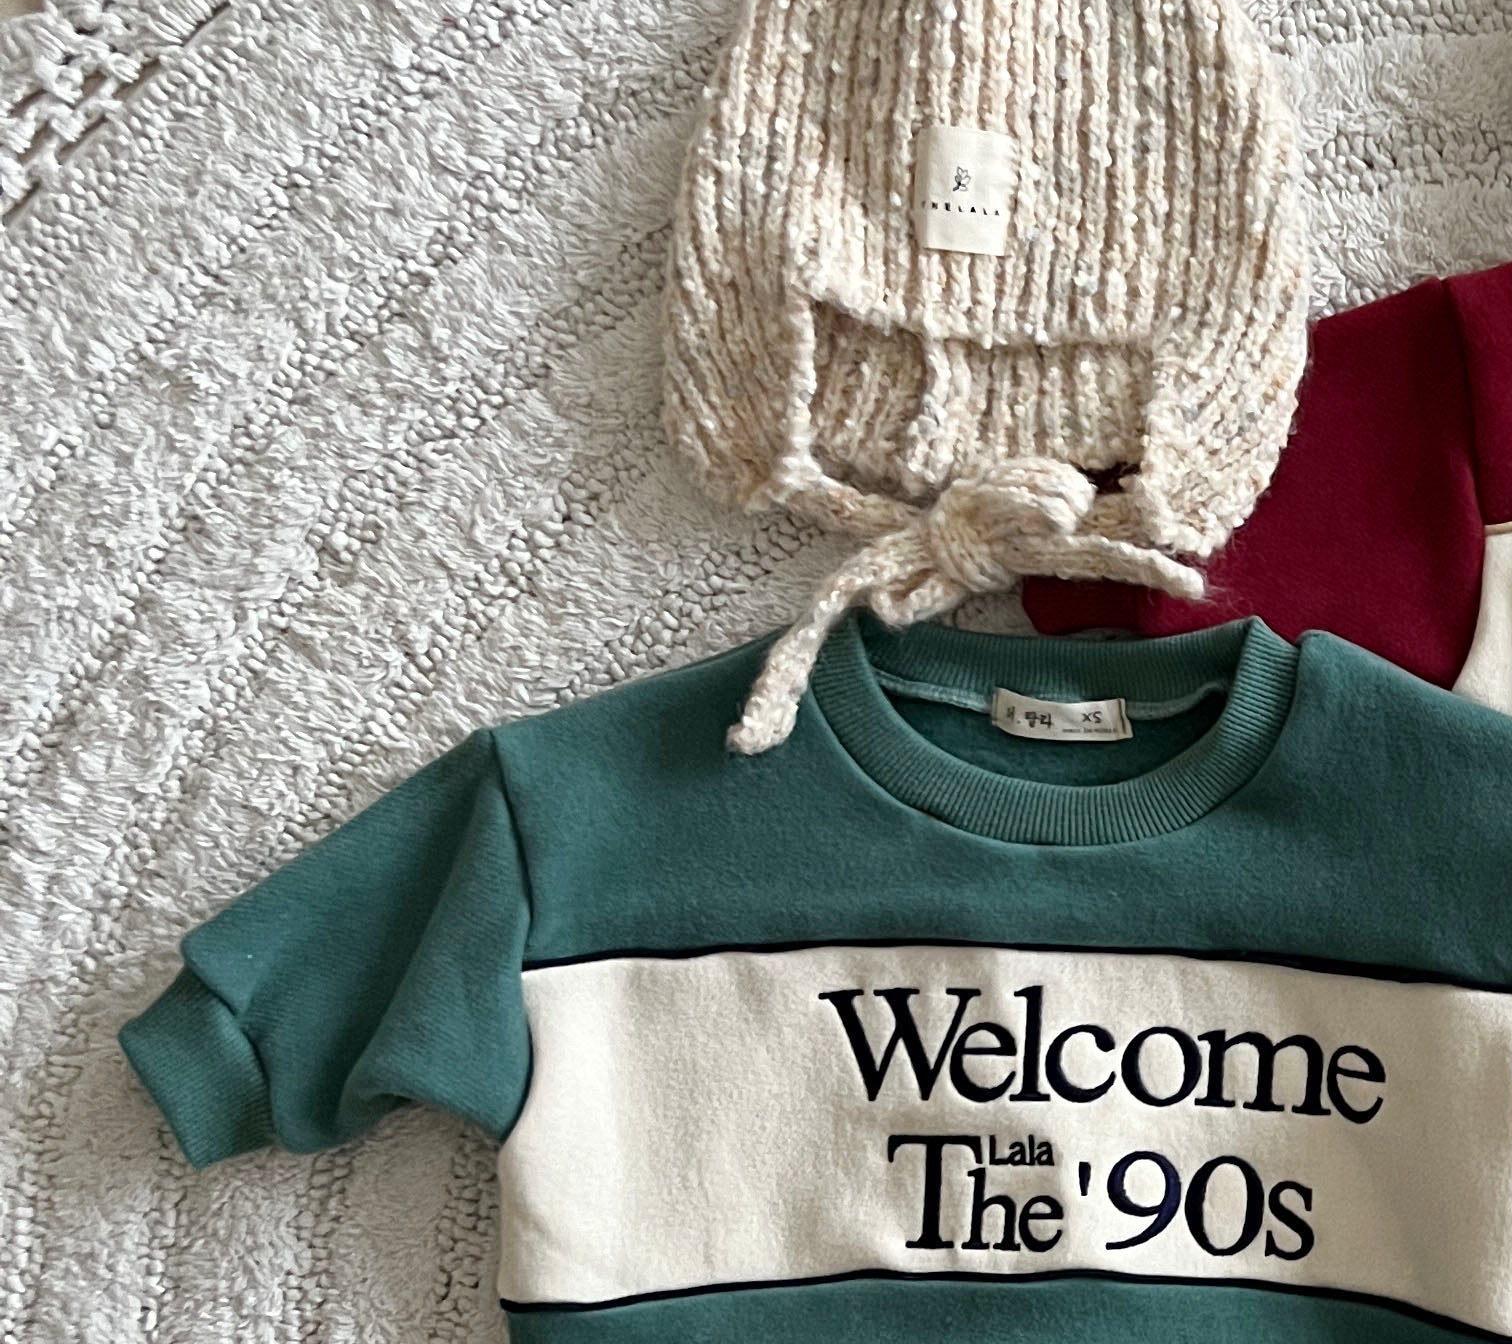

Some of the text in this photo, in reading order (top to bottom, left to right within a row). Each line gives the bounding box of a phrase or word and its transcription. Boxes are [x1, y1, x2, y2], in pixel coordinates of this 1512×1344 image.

[1081, 711, 1104, 724] XS
[818, 985, 1387, 1124] Welcome
[988, 1134, 1055, 1166] Lala
[887, 1134, 1315, 1260] The '90s
